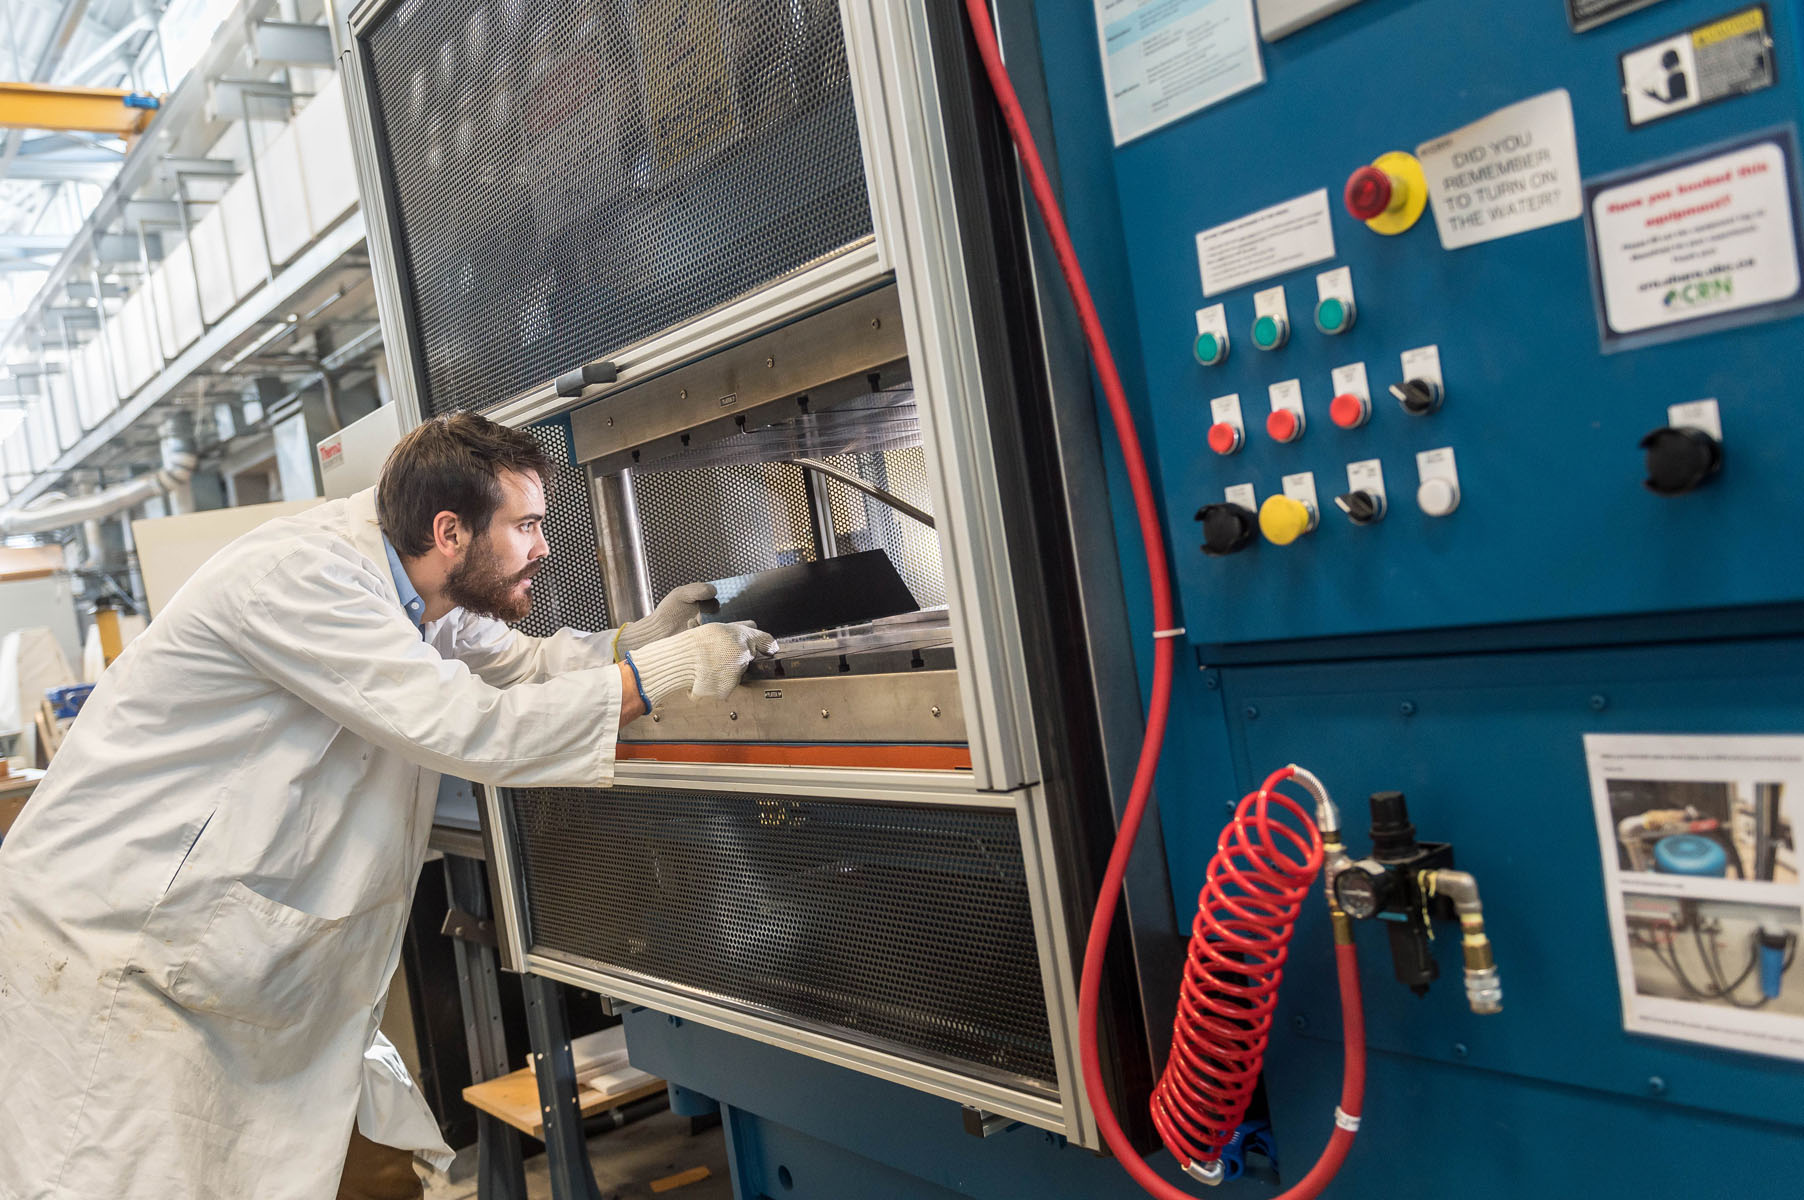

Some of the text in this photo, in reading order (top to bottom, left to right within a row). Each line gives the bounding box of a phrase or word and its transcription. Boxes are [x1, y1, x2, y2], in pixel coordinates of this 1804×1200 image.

[1443, 148, 1550, 191] REMEMBER
[1452, 146, 1486, 168] DID
[1491, 131, 1531, 153] YOU
[1446, 170, 1558, 211] TO TURN ON
[1448, 190, 1561, 231] THE WATER?
[1607, 199, 1642, 213] Have
[1649, 190, 1672, 205] you
